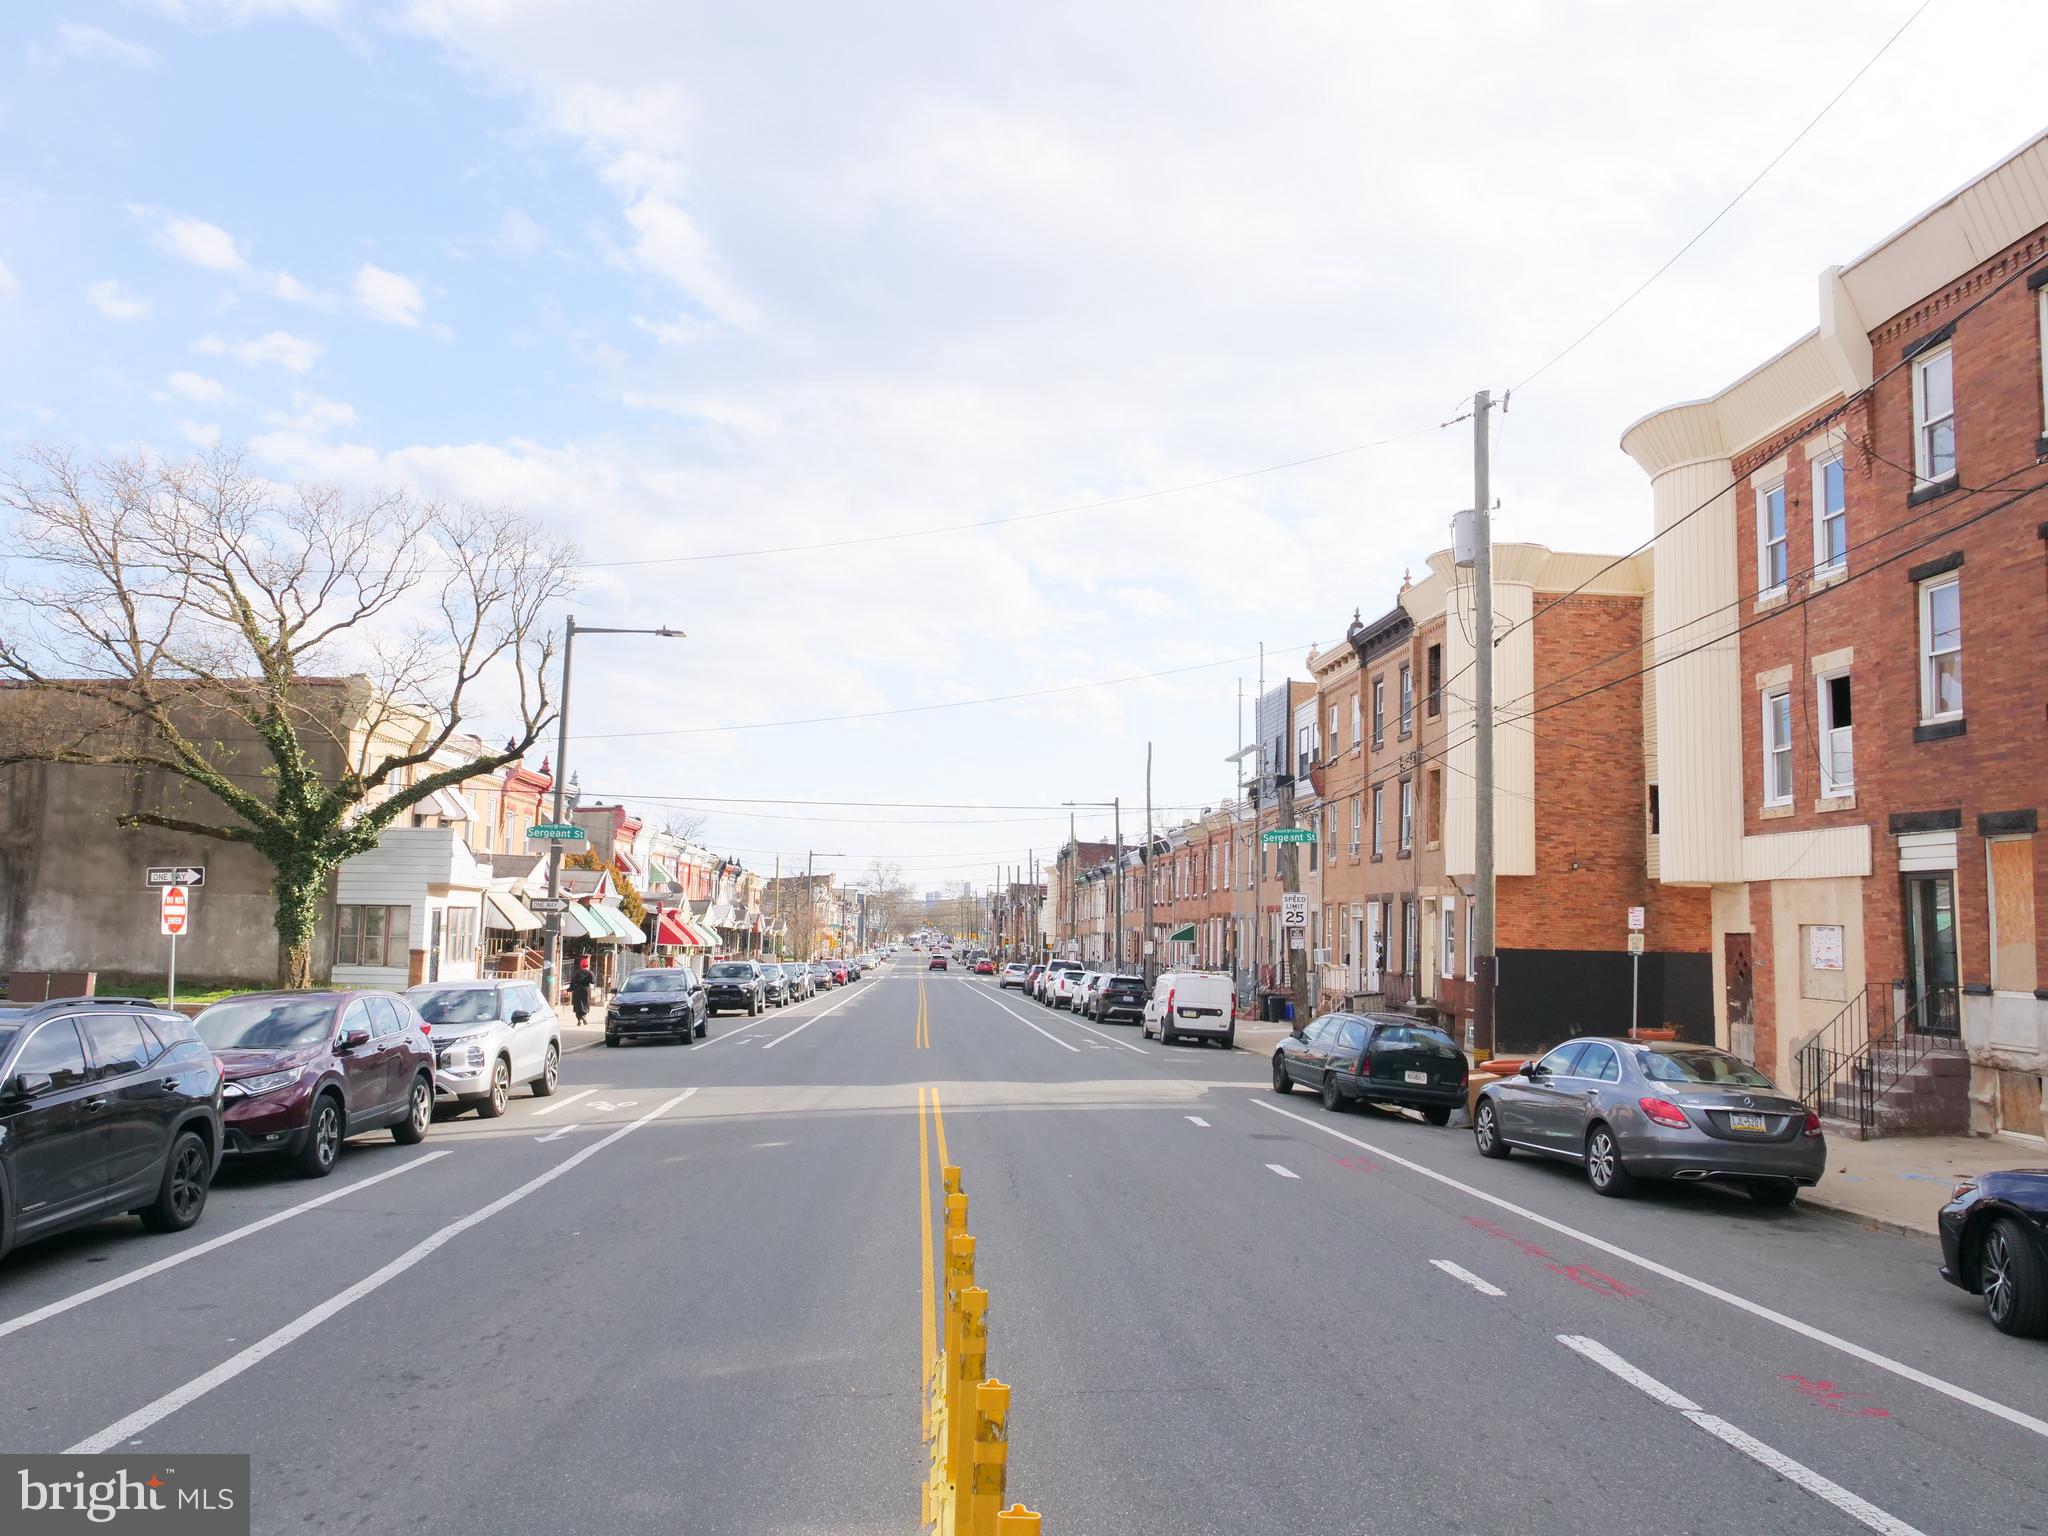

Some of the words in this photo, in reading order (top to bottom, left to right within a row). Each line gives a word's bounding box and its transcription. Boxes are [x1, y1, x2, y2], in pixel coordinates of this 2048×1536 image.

[528, 829, 571, 839] Sergeant
[574, 830, 584, 839] St
[1263, 833, 1304, 843] Sergeant
[1306, 833, 1316, 841] St
[153, 873, 169, 881] ONE
[166, 896, 174, 905] DO
[174, 896, 184, 905] NOT
[167, 916, 183, 925] ENTER
[1285, 911, 1305, 923] 25
